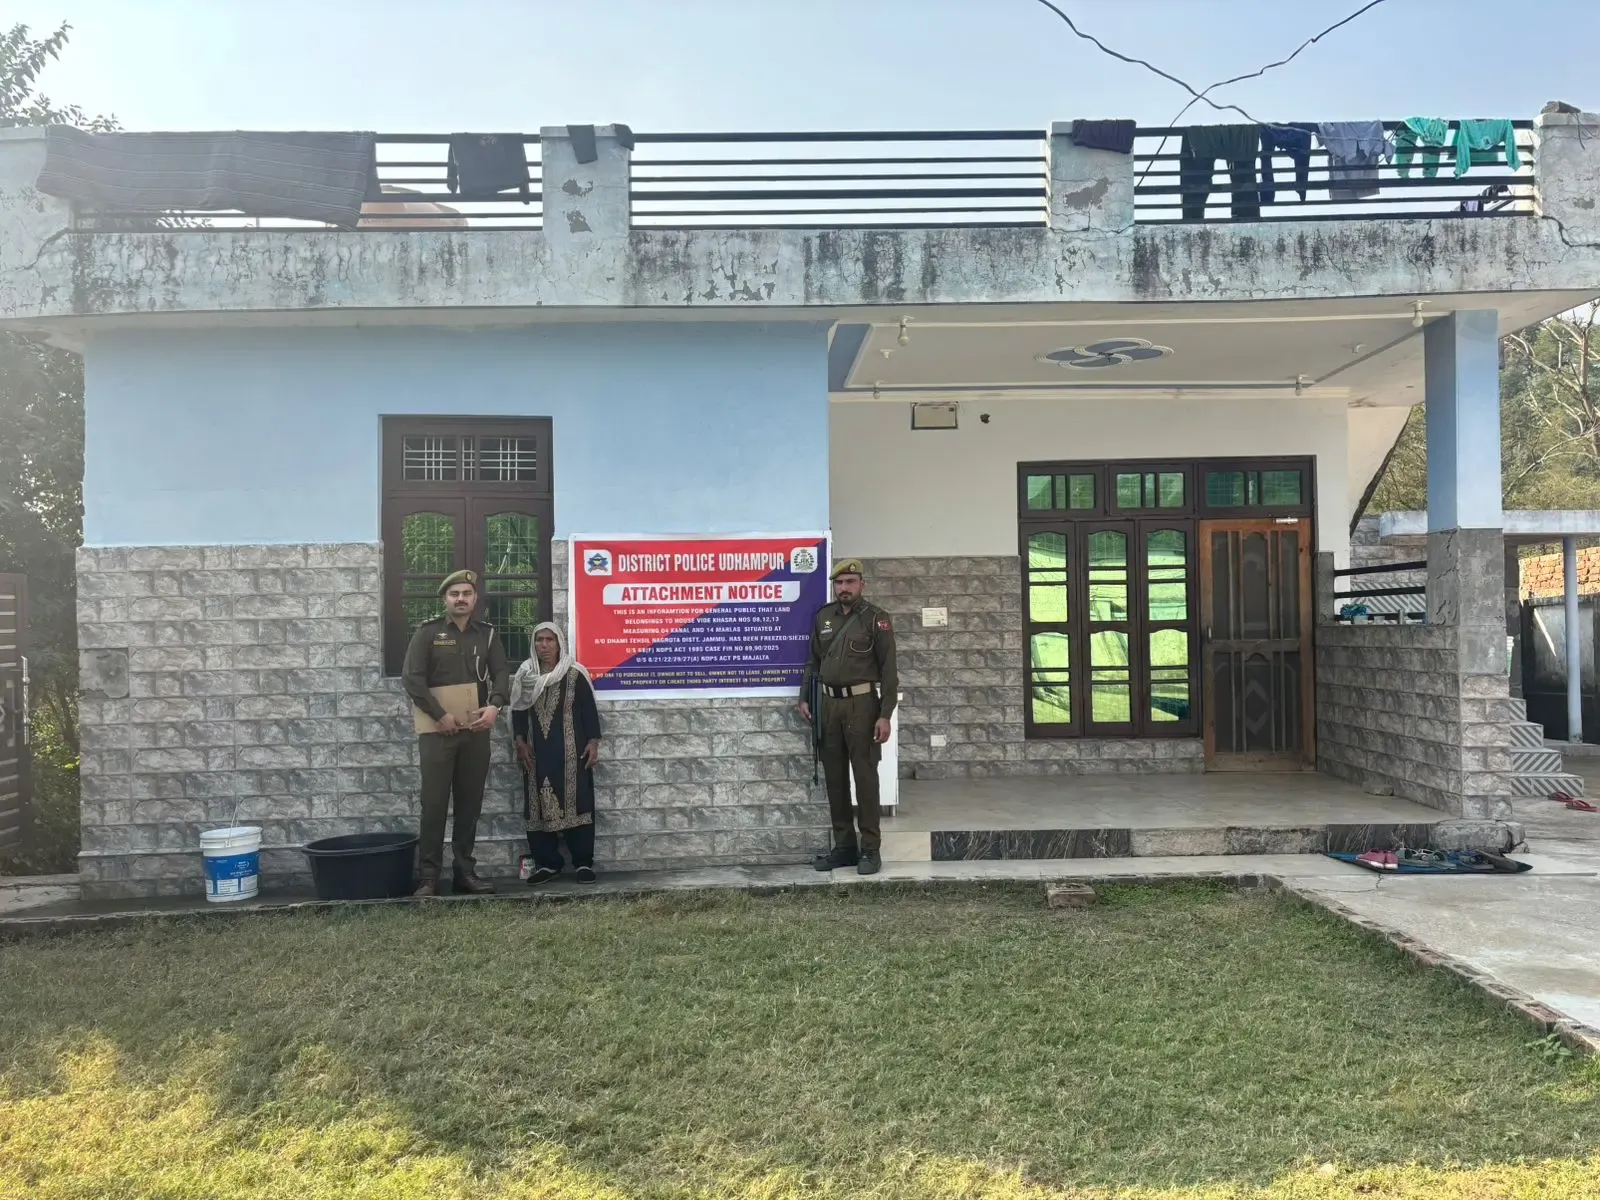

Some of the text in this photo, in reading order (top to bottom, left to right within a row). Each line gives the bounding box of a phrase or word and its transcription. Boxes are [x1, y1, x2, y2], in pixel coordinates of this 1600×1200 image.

[618, 552, 784, 572] DISTRICT POLICE UDHAMPUR
[621, 585, 782, 601] ATTACHMENT NOTICE
